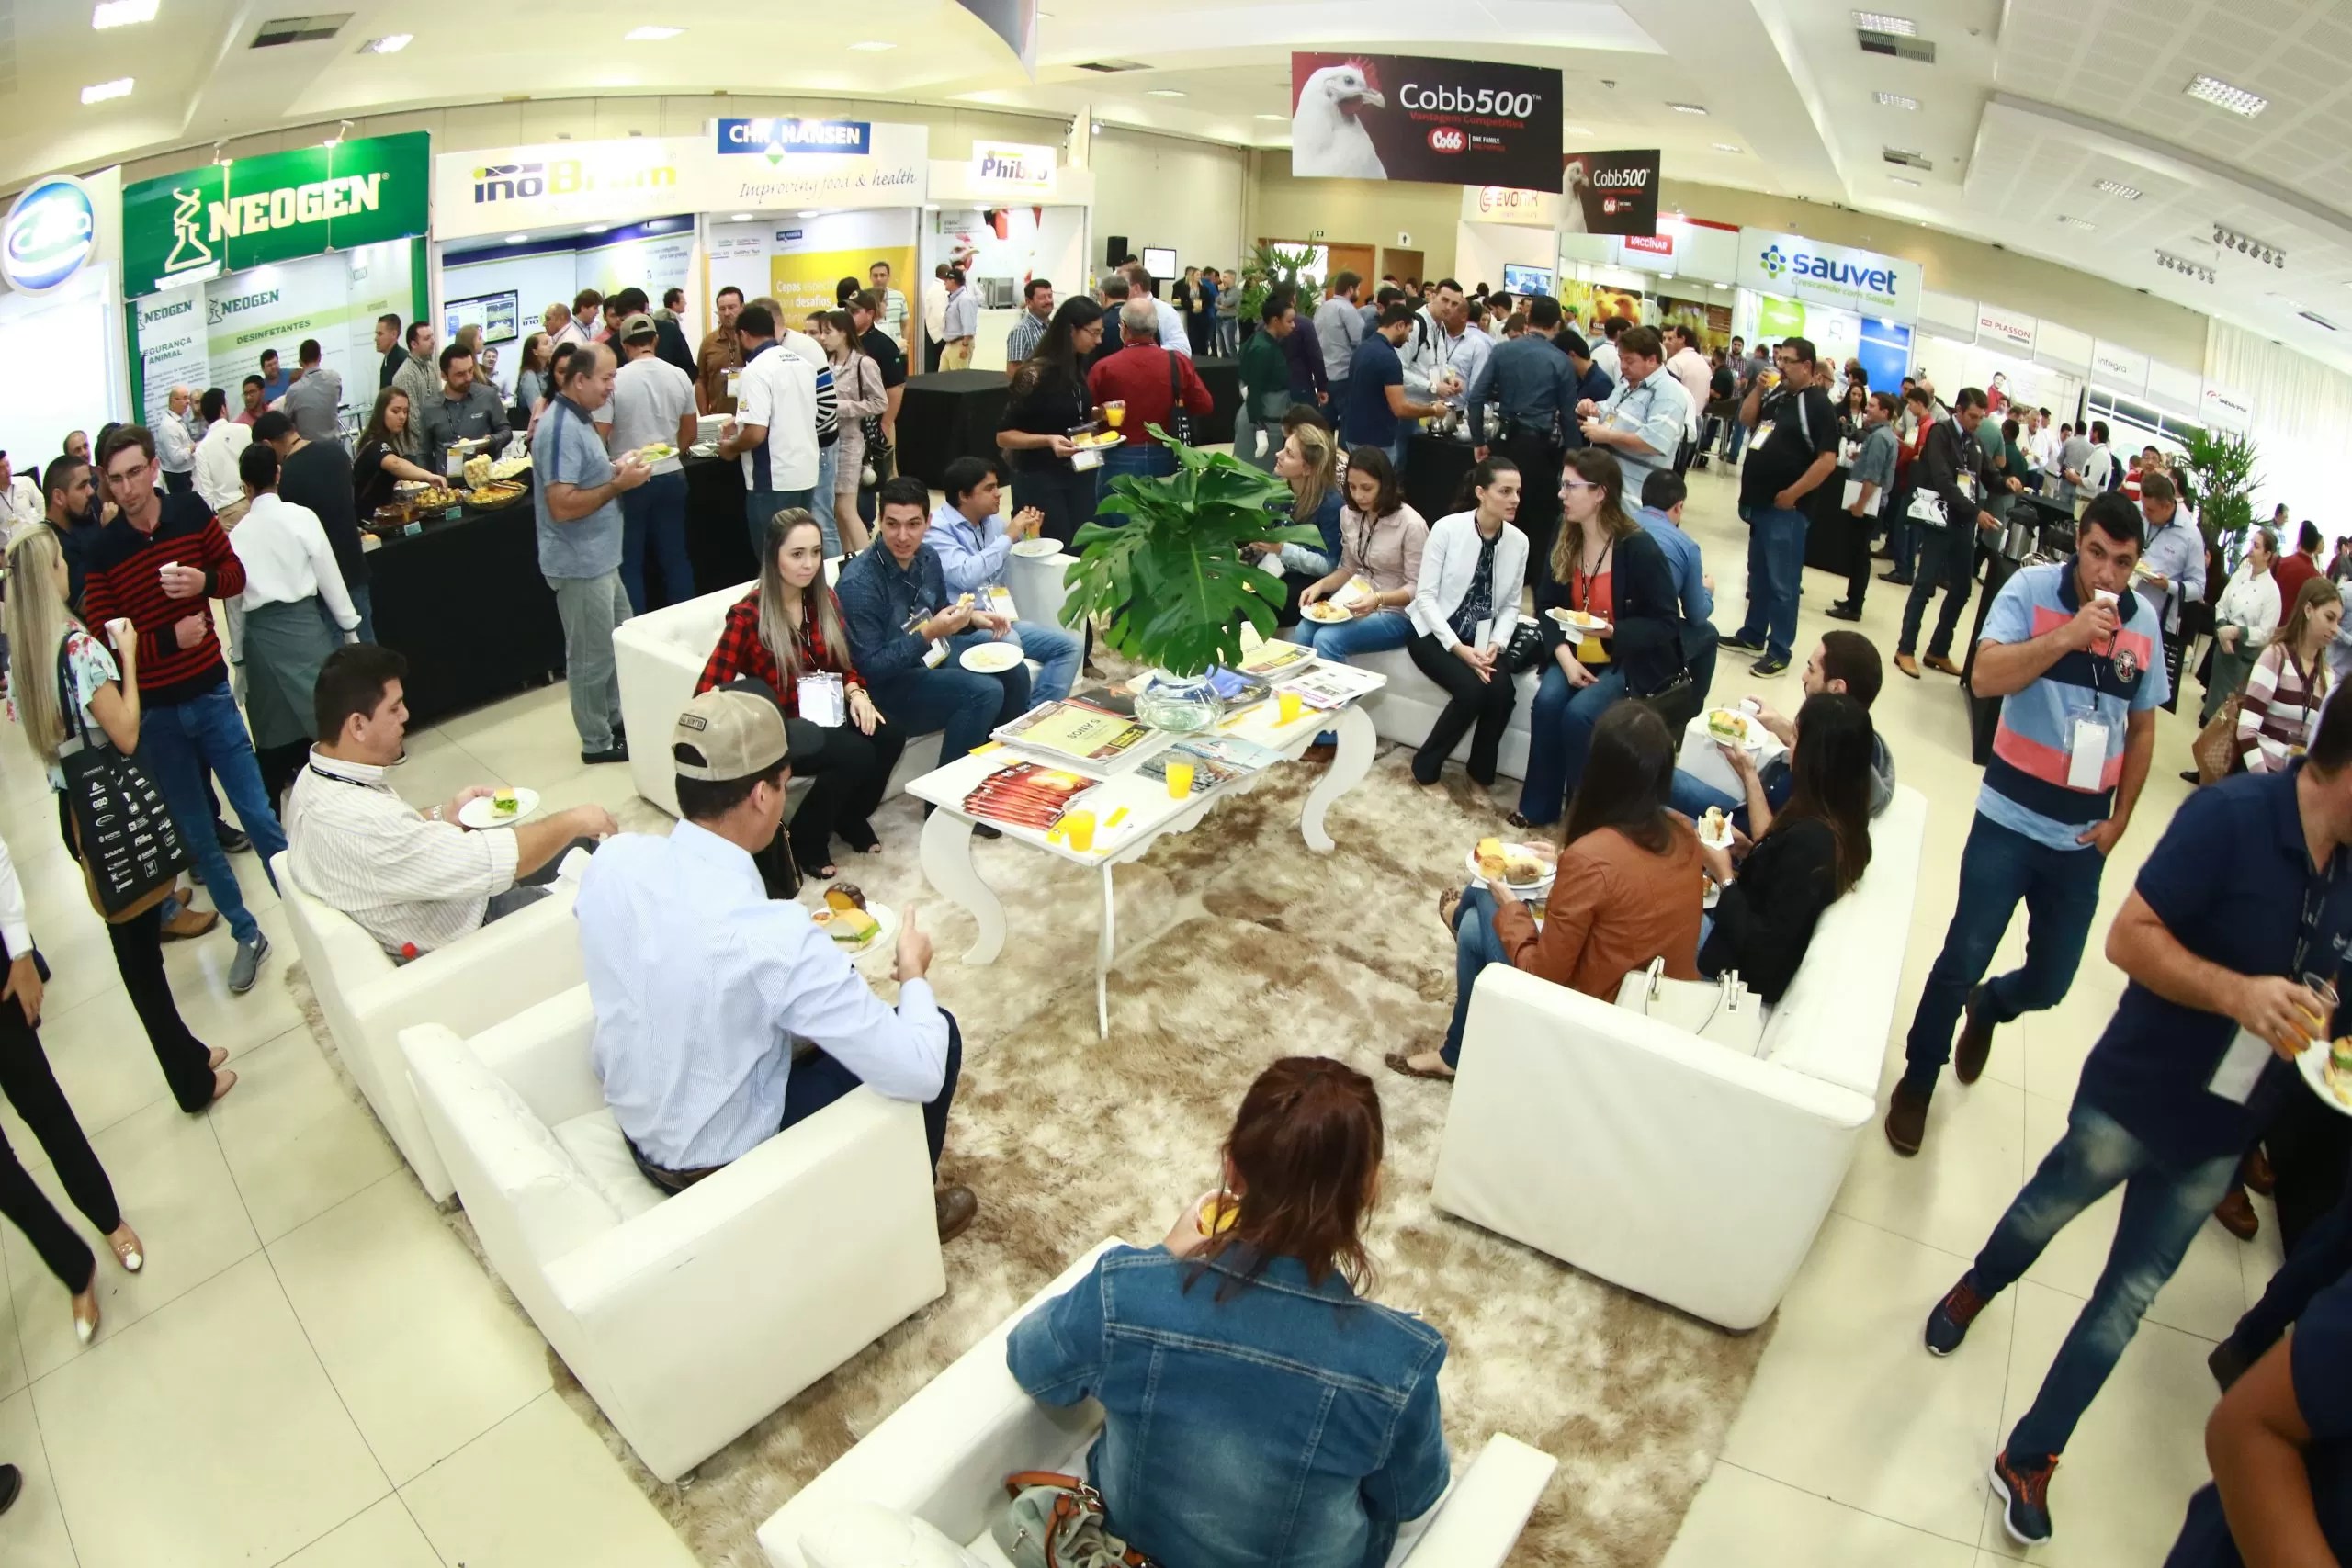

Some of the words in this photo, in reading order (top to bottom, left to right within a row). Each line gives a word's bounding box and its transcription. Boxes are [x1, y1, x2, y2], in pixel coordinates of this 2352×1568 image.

[781, 125, 861, 144] HANSEN
[474, 159, 676, 203] inoBn
[739, 177, 818, 204] Improving
[872, 167, 917, 186] health
[1792, 253, 1897, 295] sauvet
[776, 281, 802, 295] Cepas
[1792, 276, 1841, 294] Crescendo
[144, 299, 192, 324] NEOGEN
[221, 288, 280, 316] NEOGEN
[796, 295, 831, 309] desafios
[236, 320, 311, 345] DESINFETANTES
[1994, 321, 2030, 339] PLASSON
[148, 350, 183, 366] ANIMAL
[2098, 356, 2127, 373] integra
